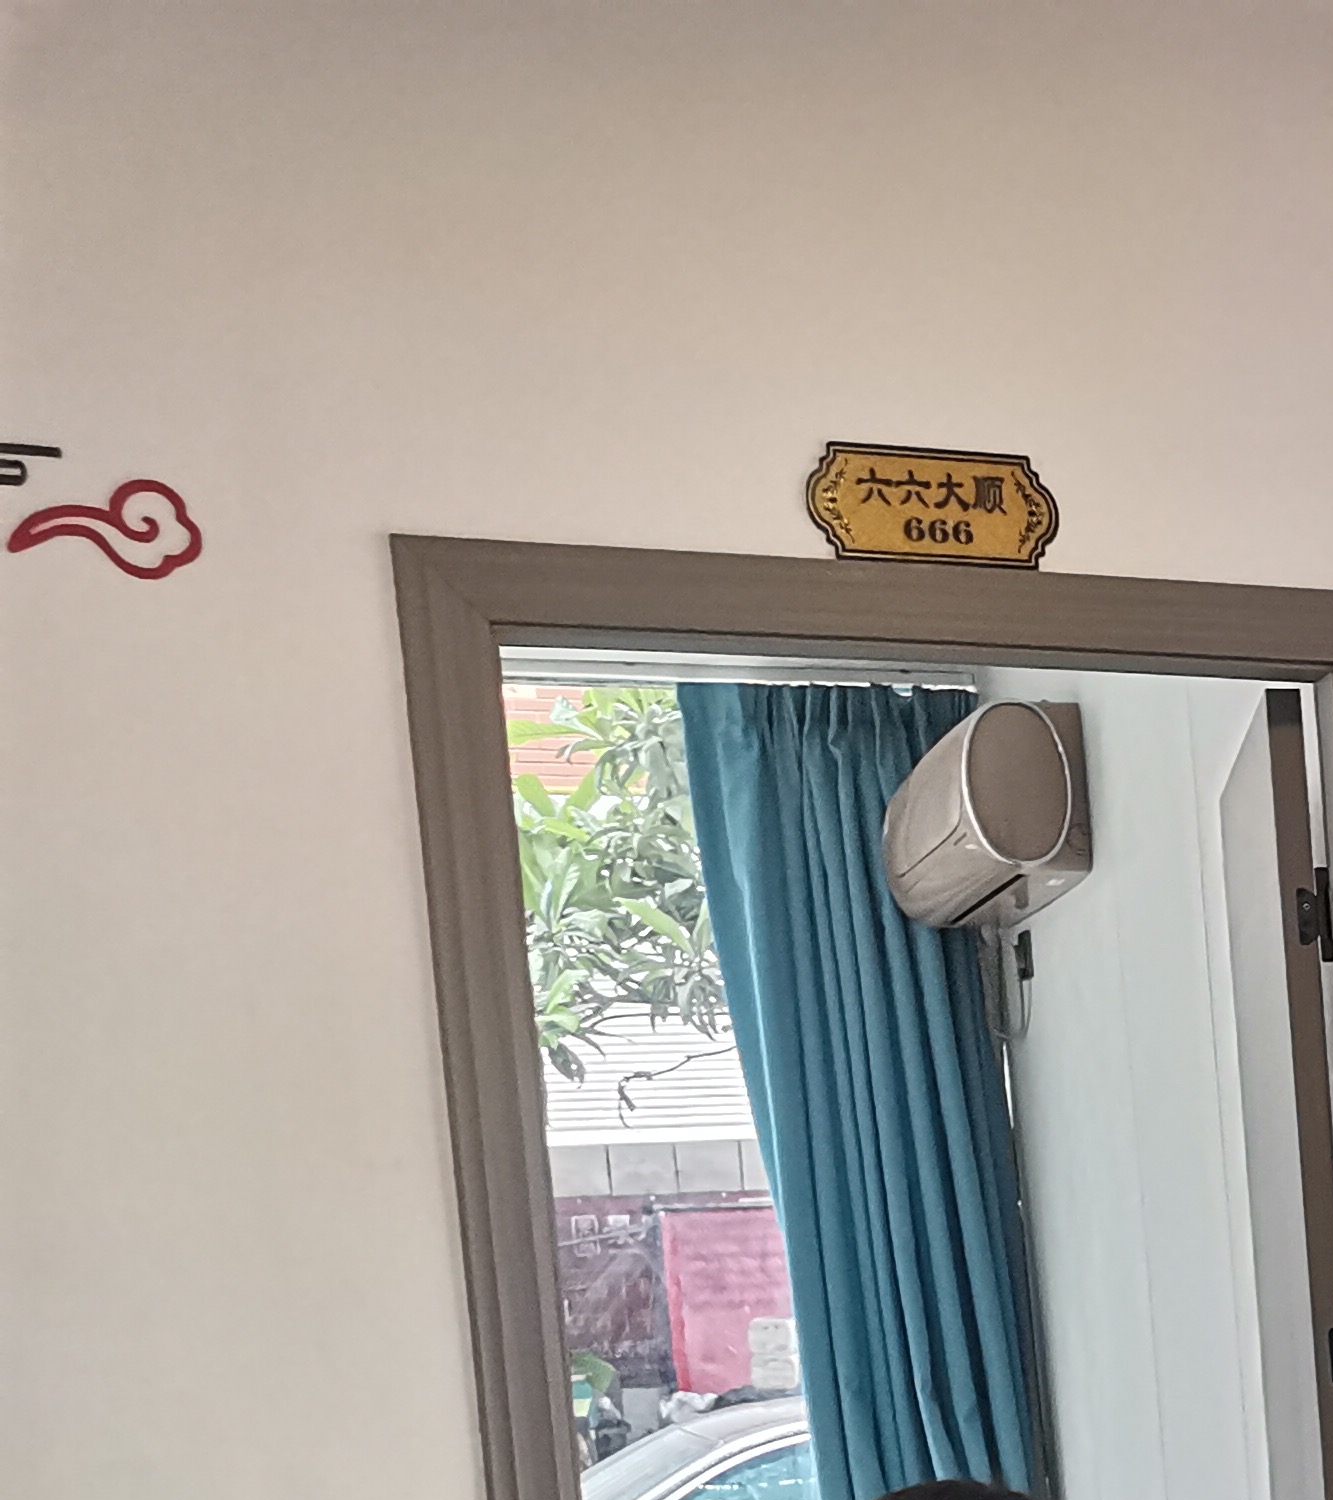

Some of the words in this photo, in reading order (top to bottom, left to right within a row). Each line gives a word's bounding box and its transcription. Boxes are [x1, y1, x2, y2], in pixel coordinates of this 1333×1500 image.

[856, 467, 1008, 516] 六六大顺
[904, 517, 974, 544] 666
